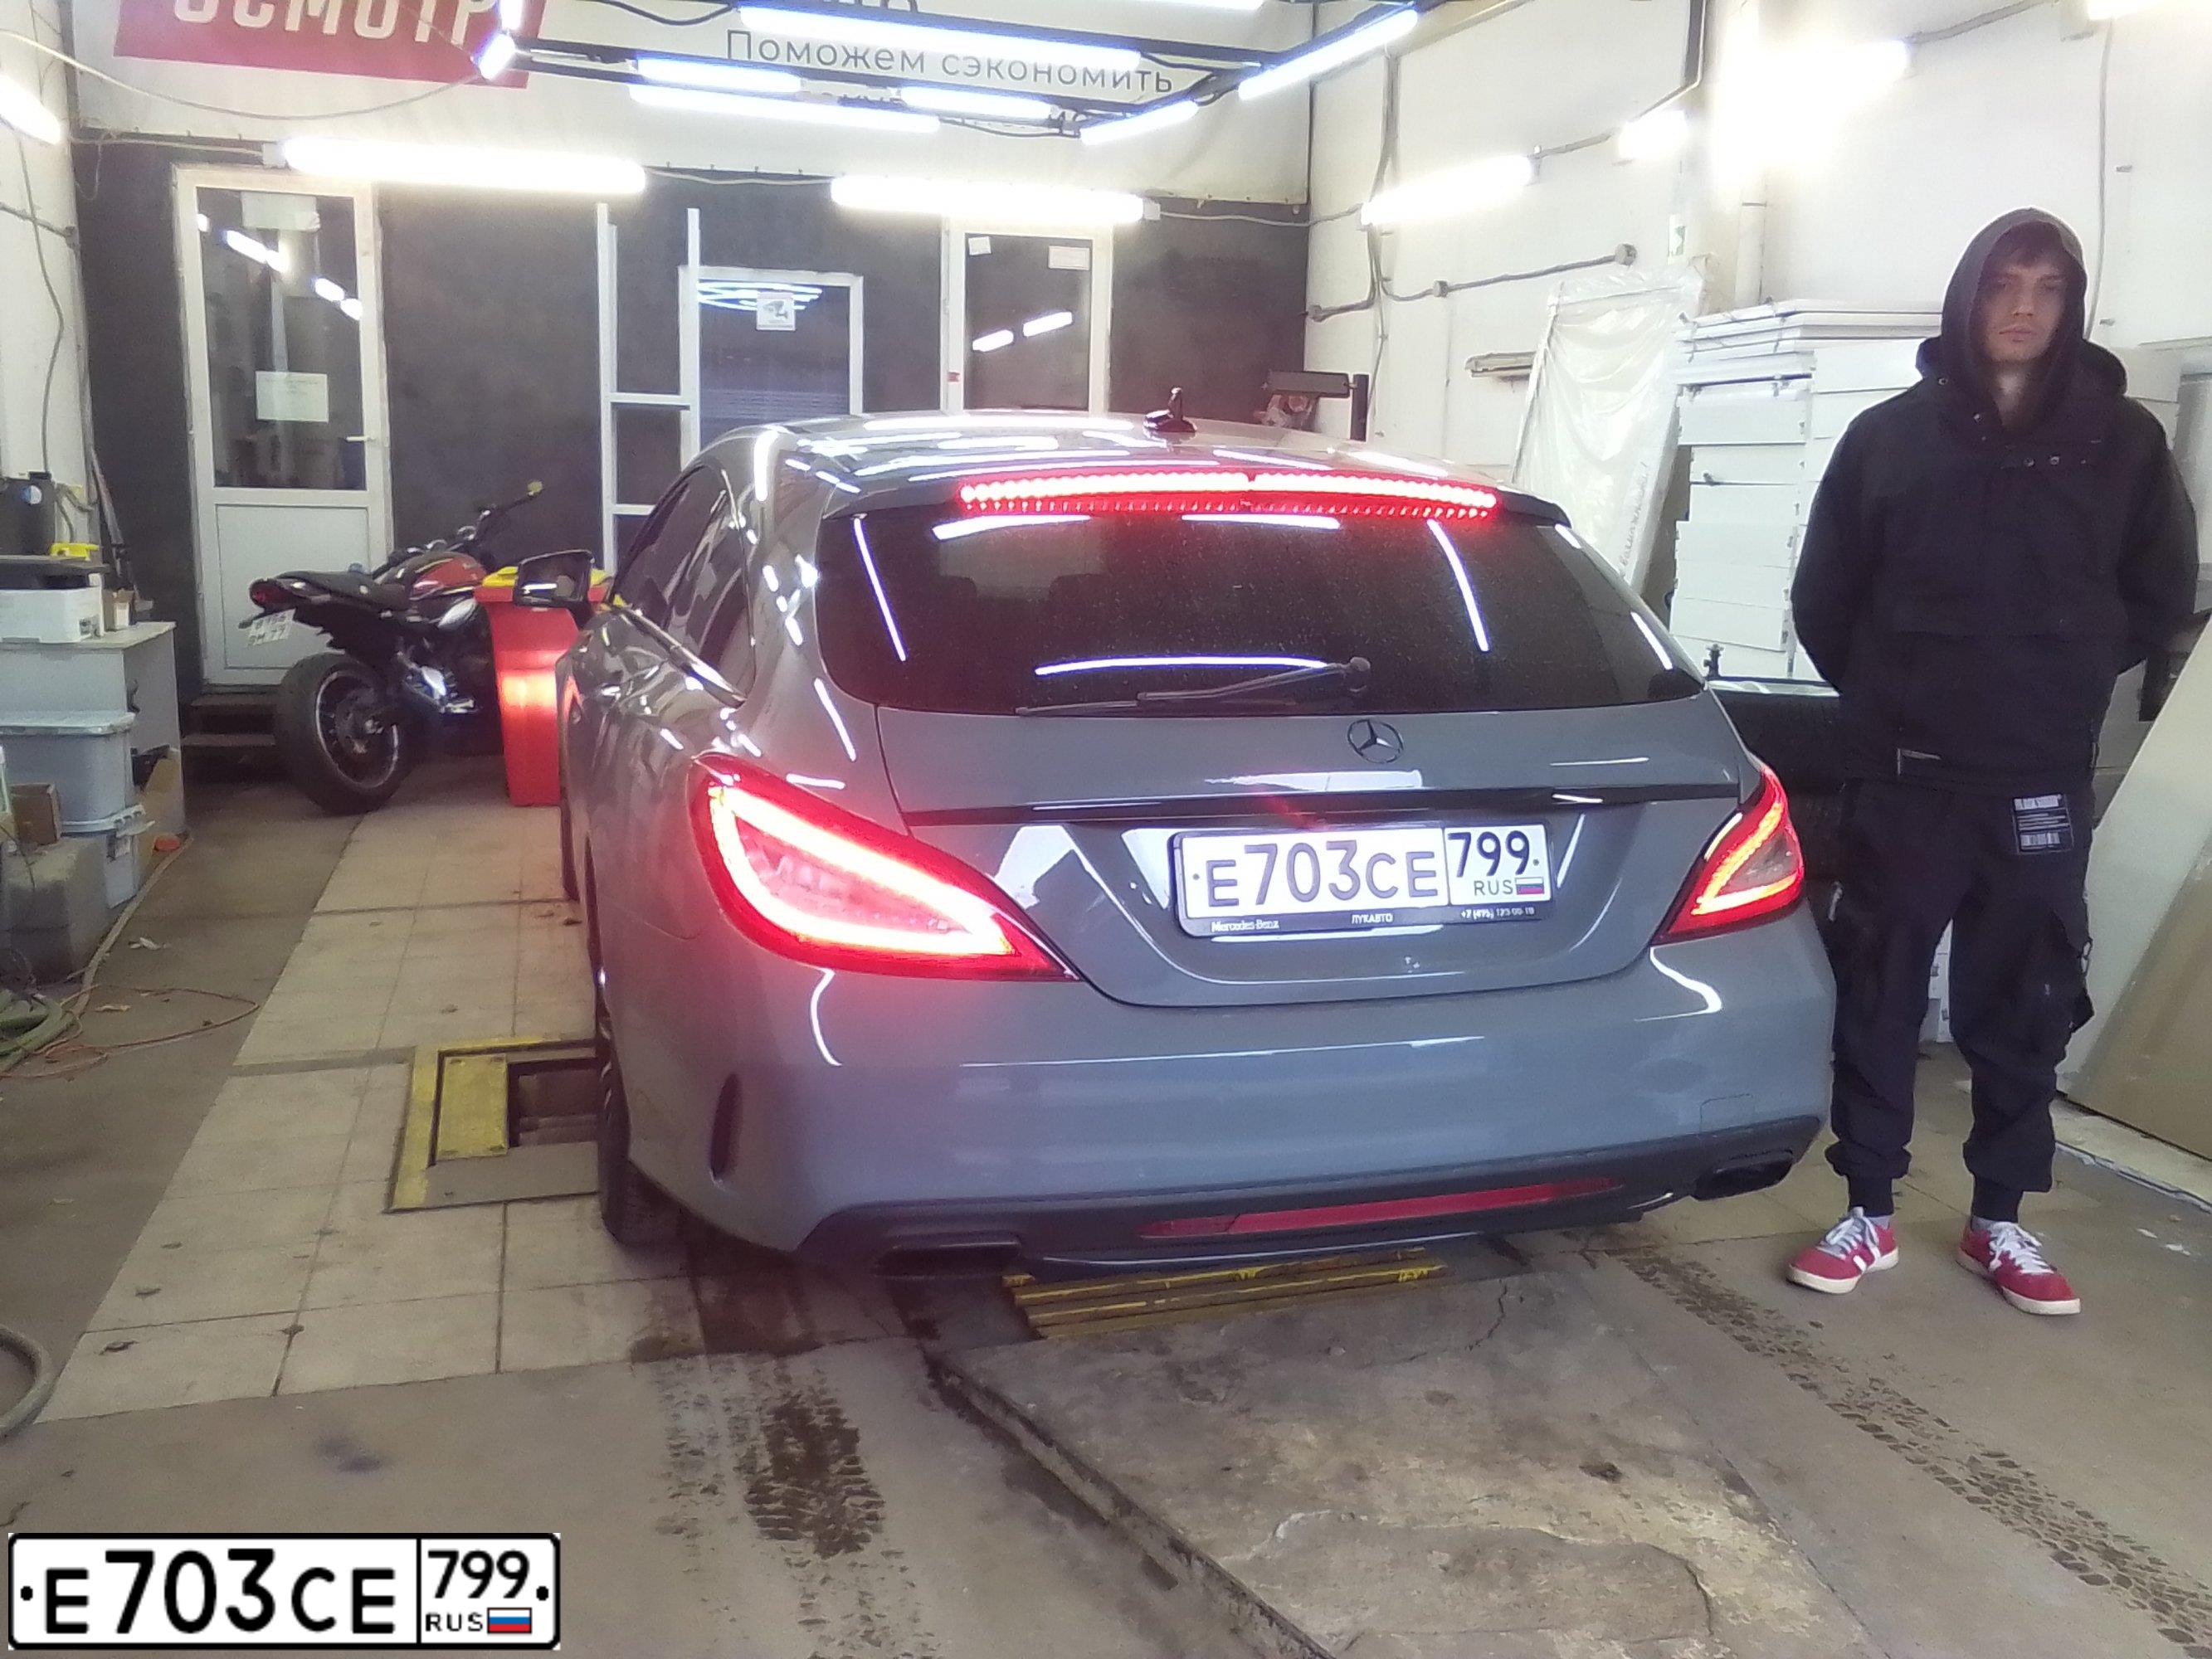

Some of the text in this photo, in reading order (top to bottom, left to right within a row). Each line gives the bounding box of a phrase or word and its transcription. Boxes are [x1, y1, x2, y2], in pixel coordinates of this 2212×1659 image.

[727, 29, 1172, 93] Поможем сэкономить
[1448, 830, 1530, 878] 799
[1474, 879, 1513, 896] RUS
